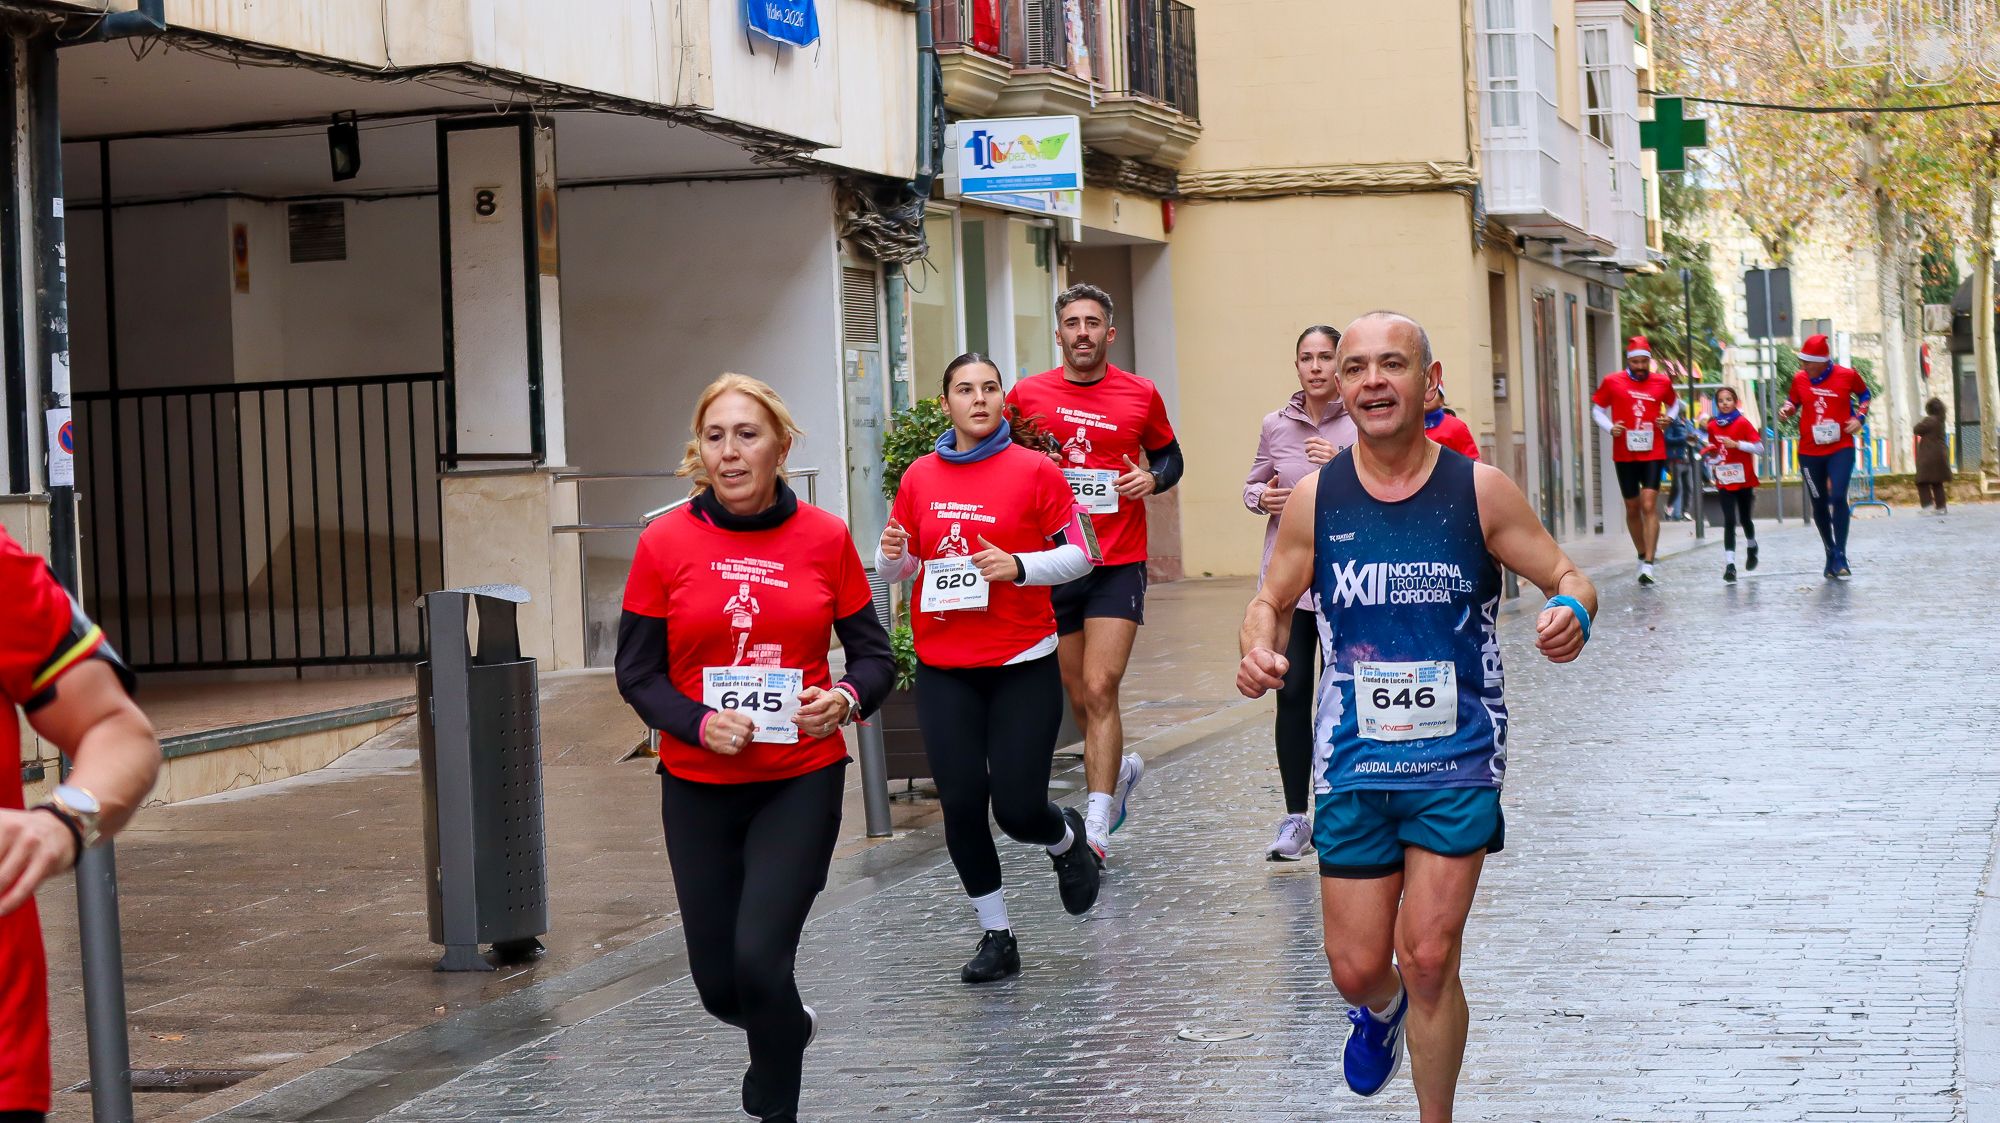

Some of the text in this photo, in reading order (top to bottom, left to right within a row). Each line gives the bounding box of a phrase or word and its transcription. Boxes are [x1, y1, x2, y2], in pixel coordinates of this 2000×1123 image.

[783, 8, 804, 28] 2026
[476, 190, 497, 216] 8
[1061, 408, 1074, 416] San
[1063, 415, 1086, 425] Ciudad
[1095, 421, 1118, 431] Lucena
[1070, 483, 1107, 497] 562
[934, 502, 947, 510] San
[947, 502, 977, 512] Silvestre
[937, 511, 996, 524] Ciudad de Lucena
[716, 562, 732, 571] San
[732, 563, 767, 576] Silvestre
[1388, 562, 1463, 578] NOCTURNA
[721, 571, 789, 589] Ciudad de Lucena
[936, 573, 977, 590] 620
[1332, 559, 1388, 609] XXII
[1388, 577, 1473, 593] TROTACALLES
[1389, 589, 1452, 604] CORDOBA
[1362, 676, 1381, 684] Ciudad
[1374, 669, 1399, 677] Silvestre
[721, 690, 783, 713] 645
[1372, 687, 1436, 710] 646
